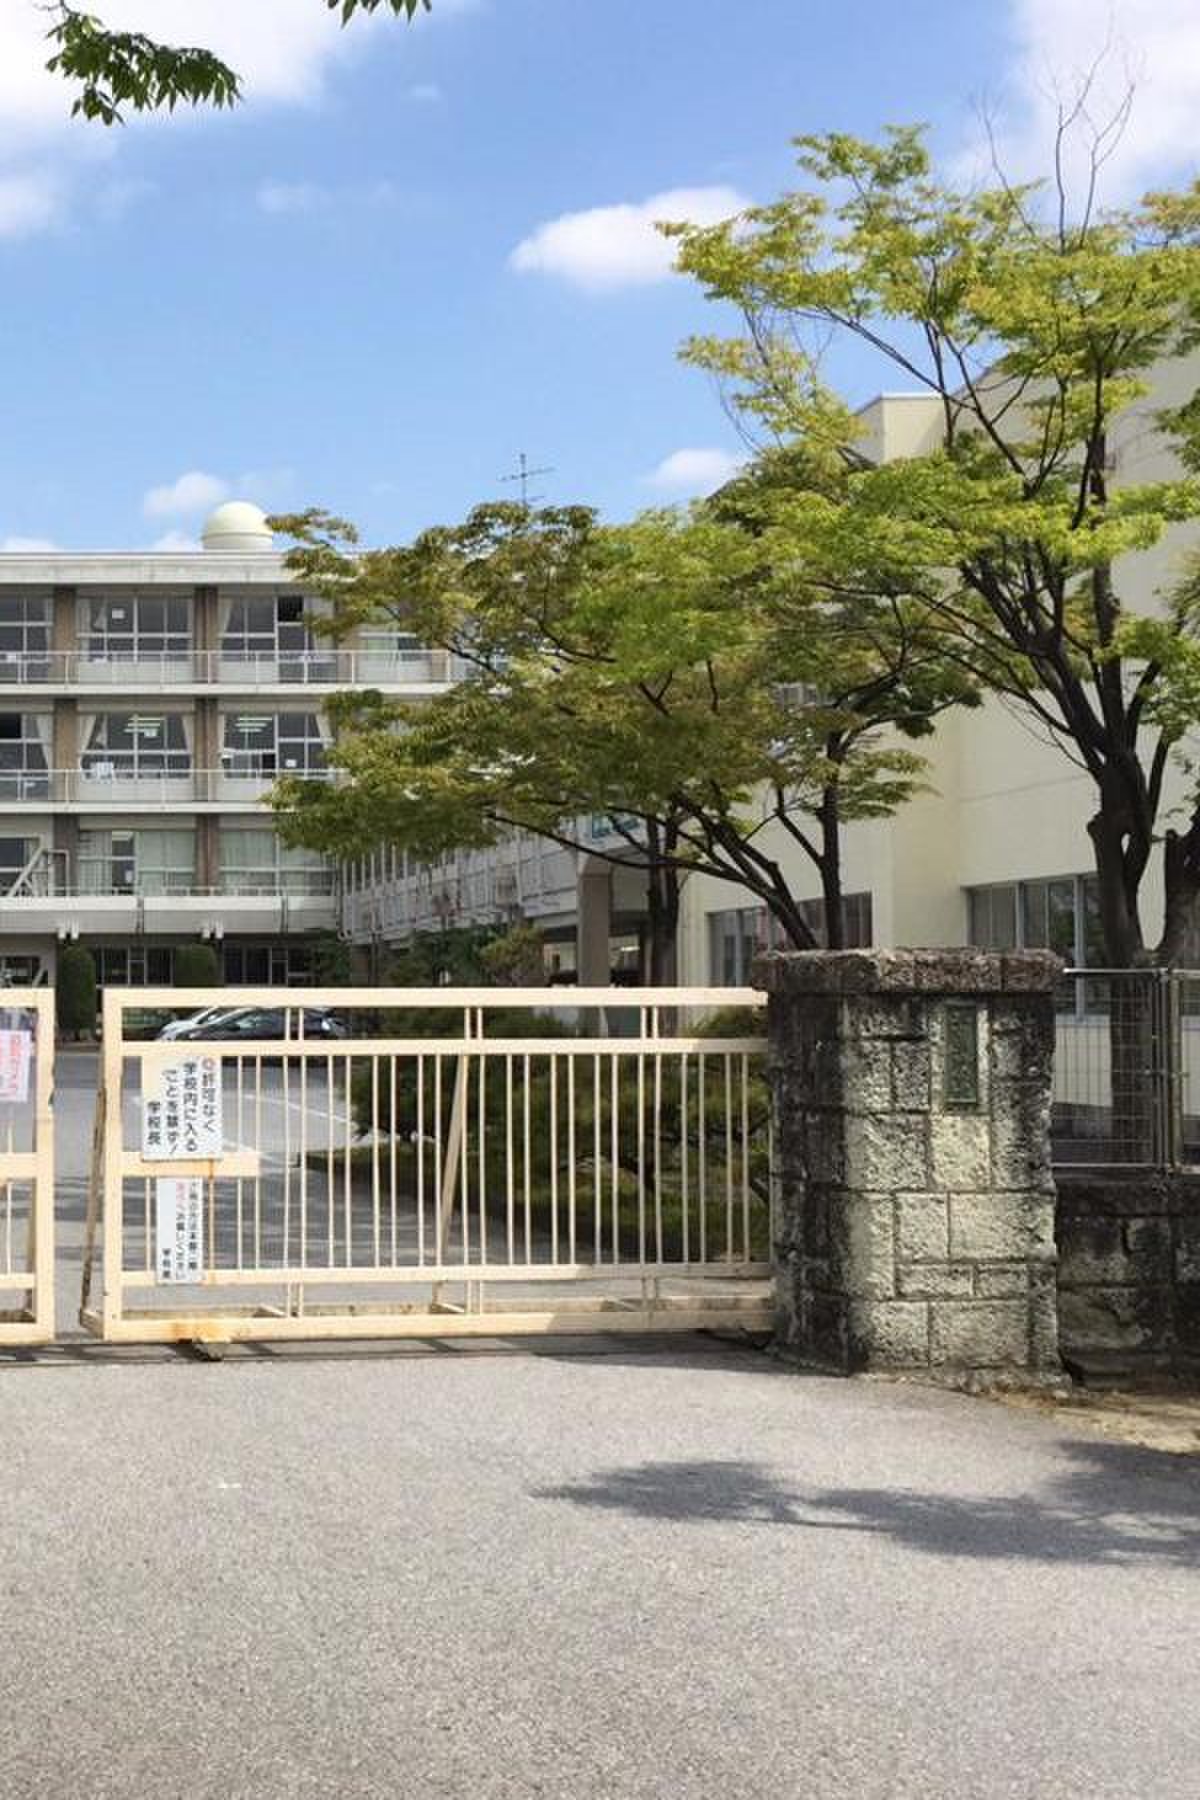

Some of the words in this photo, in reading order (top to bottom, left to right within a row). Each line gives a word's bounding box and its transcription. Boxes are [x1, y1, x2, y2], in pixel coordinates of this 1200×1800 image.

[147, 1101, 161, 1146] 学校長
[183, 1062, 198, 1152] 学校内に入る
